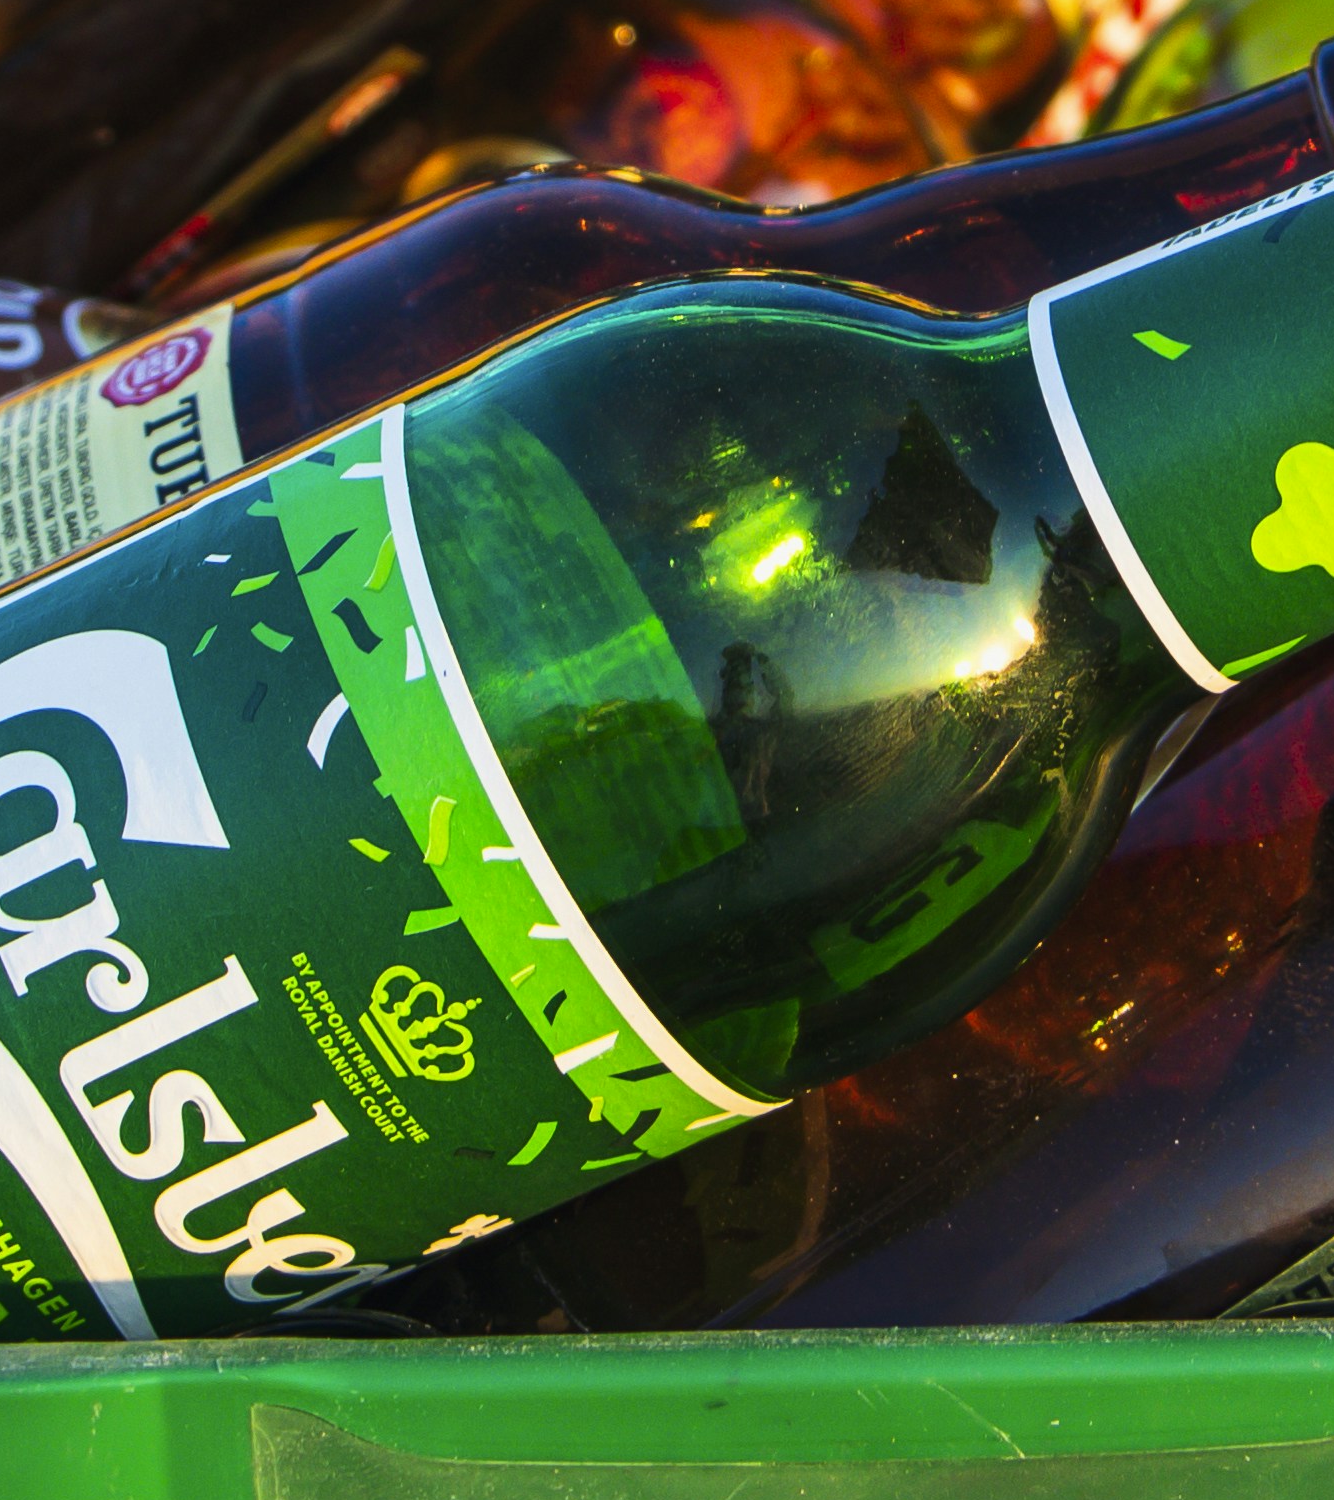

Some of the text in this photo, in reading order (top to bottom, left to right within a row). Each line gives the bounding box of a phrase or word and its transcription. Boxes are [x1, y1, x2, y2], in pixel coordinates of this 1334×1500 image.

[282, 975, 405, 1143] ROYAL DANISH COURT
[291, 952, 430, 1144] BY APPOINTMENT TO THE
